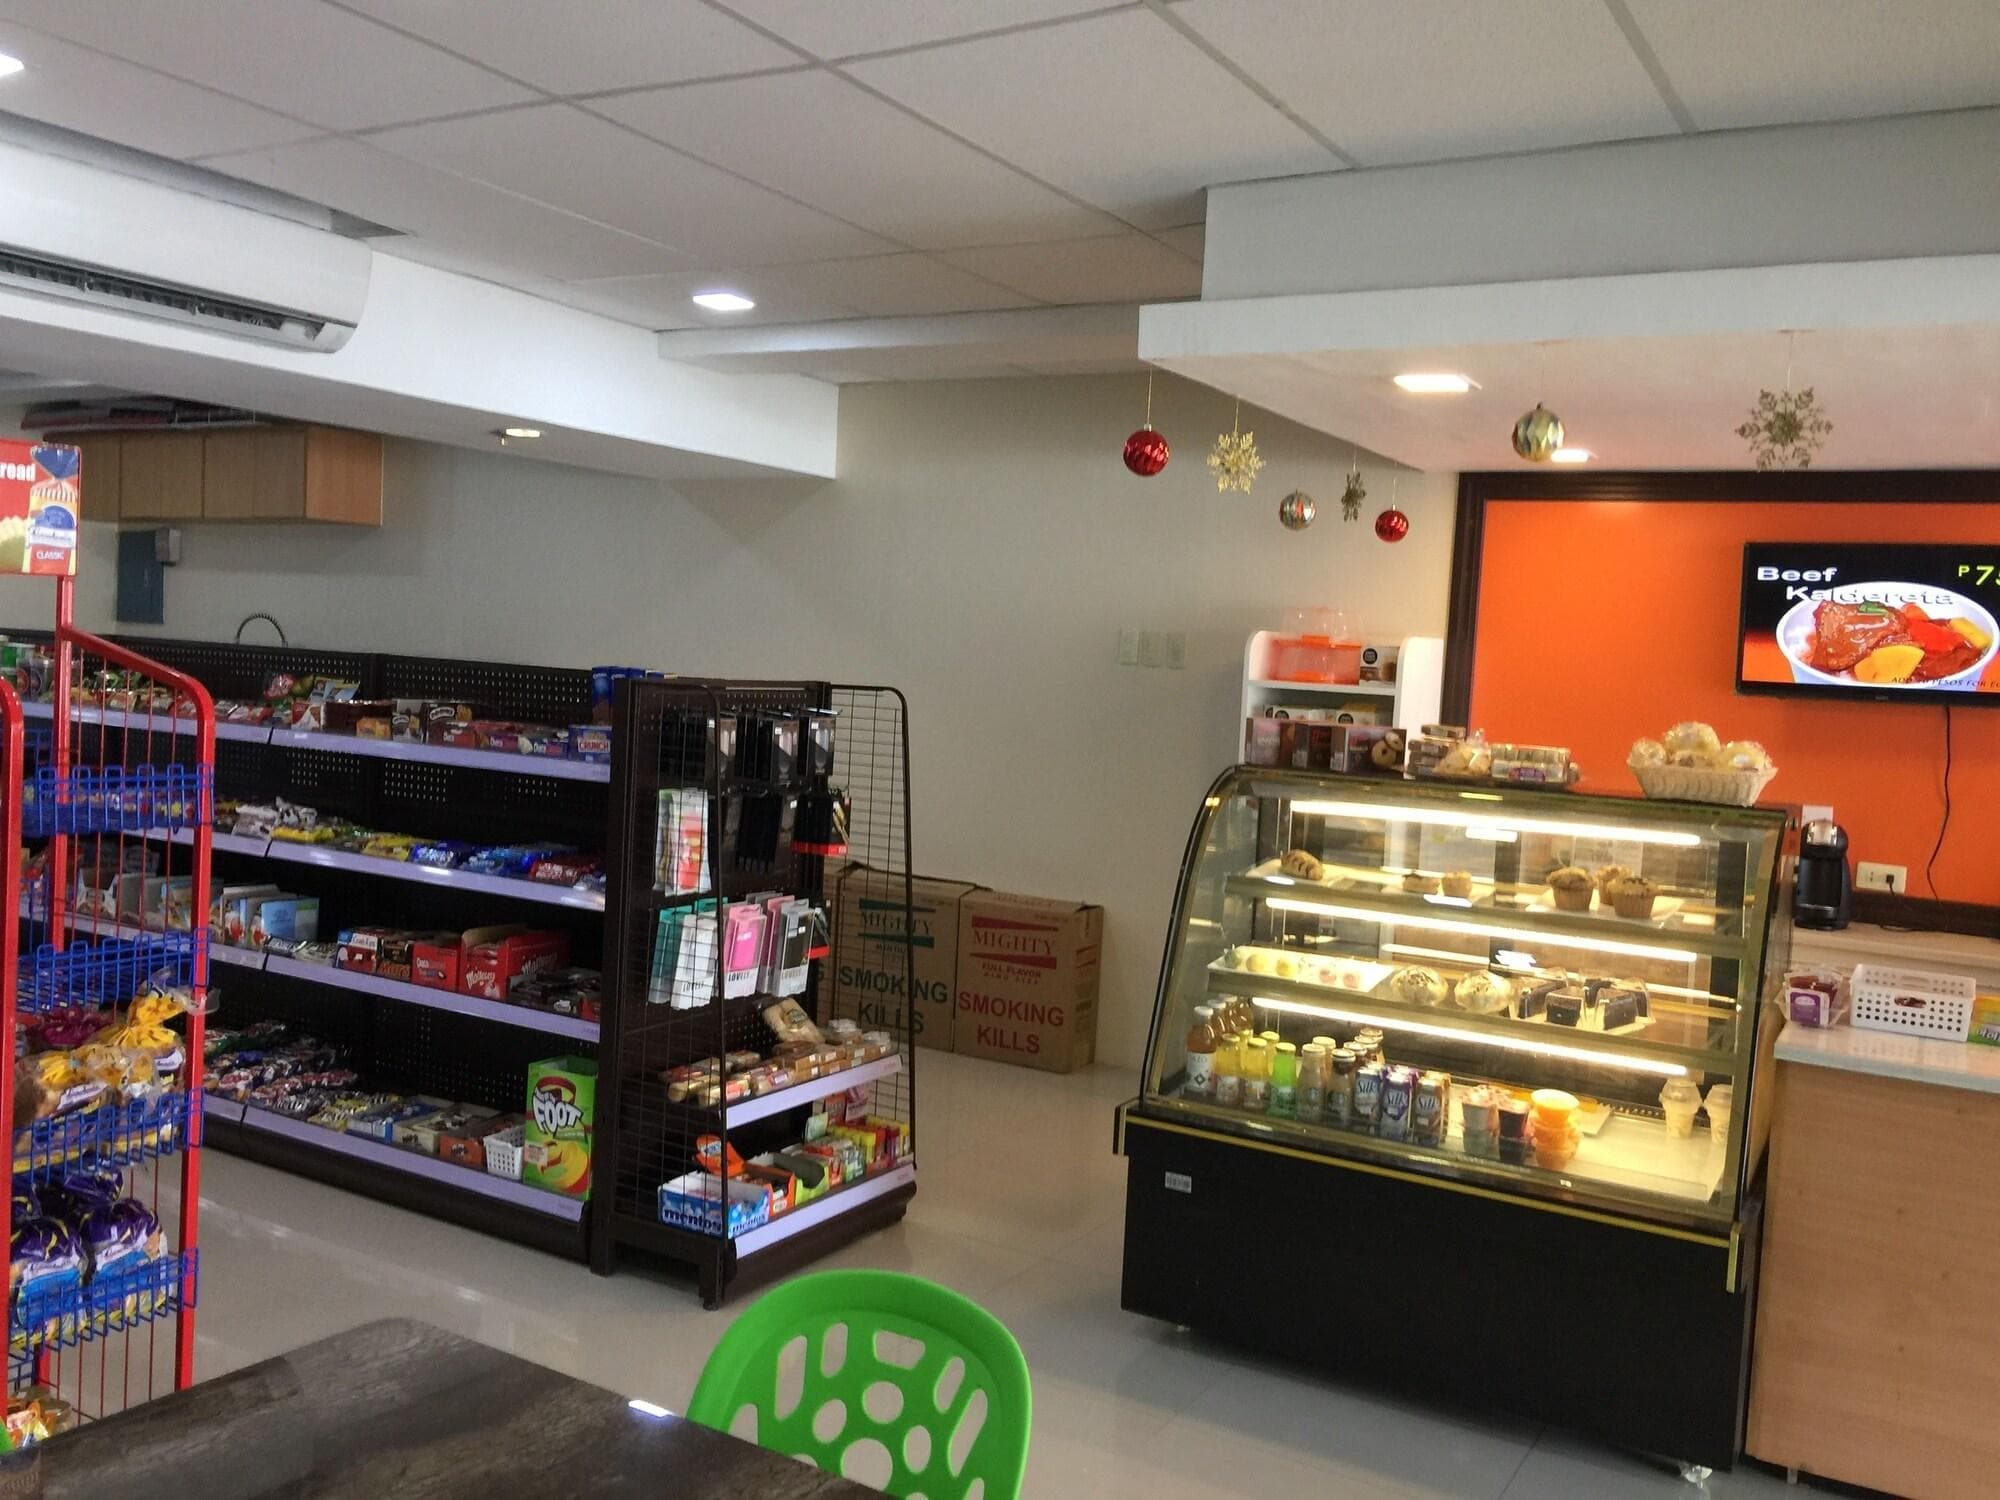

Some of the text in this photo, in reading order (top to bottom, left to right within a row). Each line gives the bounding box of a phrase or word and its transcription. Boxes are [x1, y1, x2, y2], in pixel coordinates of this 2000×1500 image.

[1757, 566, 1838, 582] Beef
[973, 930, 1055, 955] MIGHTY
[839, 966, 948, 1004] SMOKNG
[959, 991, 1065, 1028] SMOKING
[976, 1024, 1041, 1055] KILLS
[1357, 1078, 1378, 1094] Silk
[1386, 1091, 1407, 1106] Silk
[533, 1096, 583, 1135] FOOT
[663, 1208, 722, 1234] mentos
